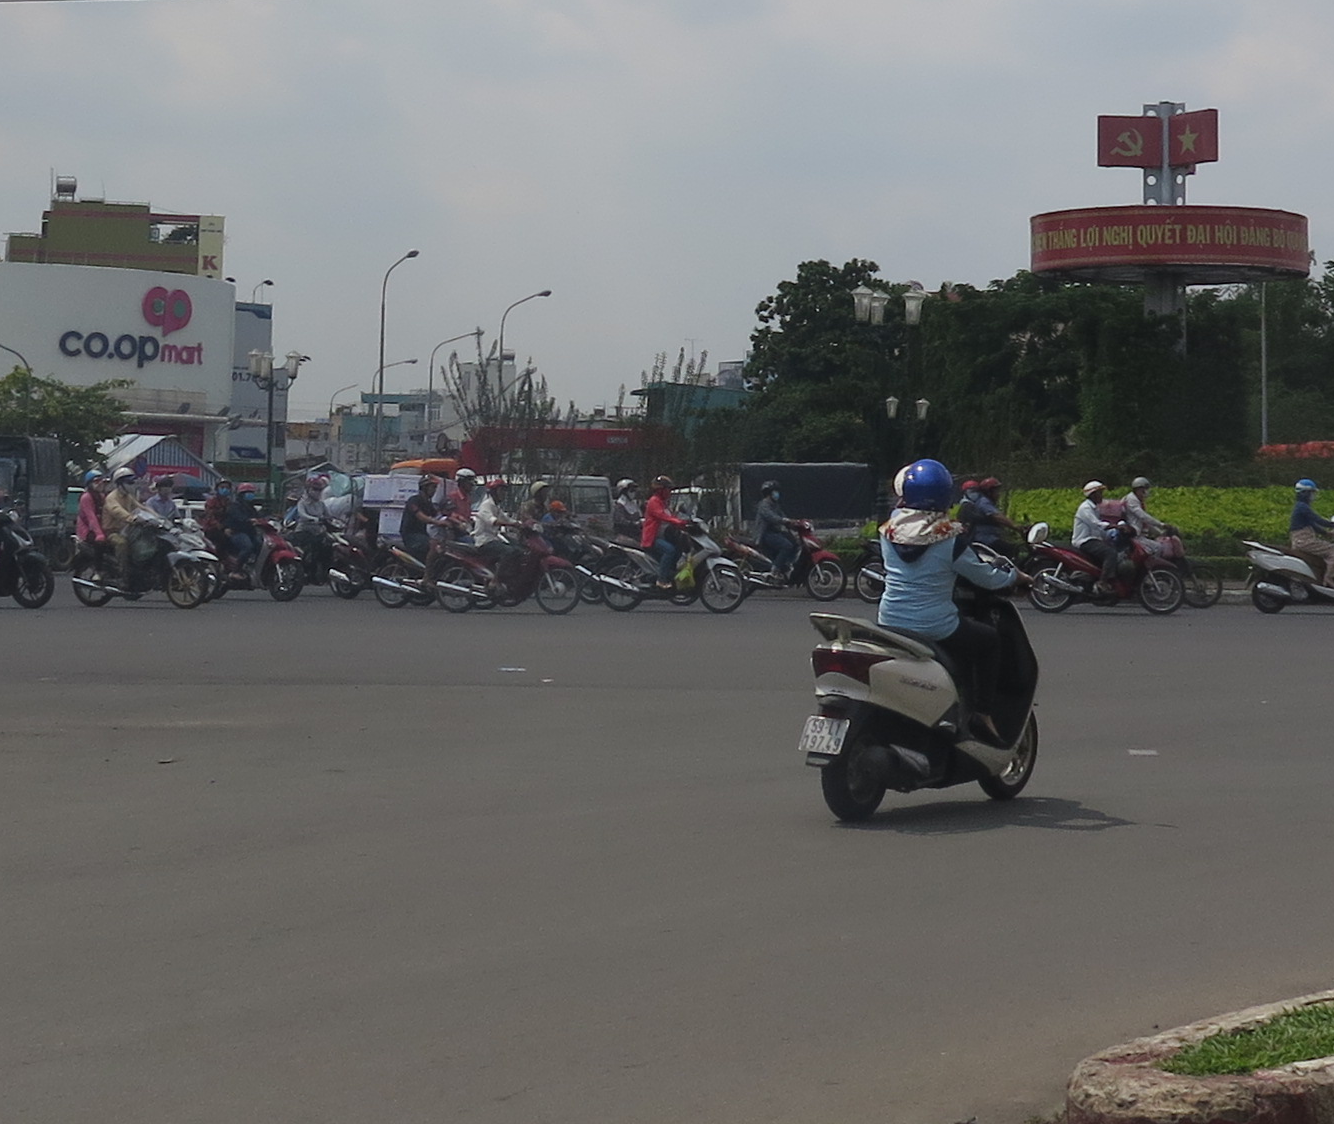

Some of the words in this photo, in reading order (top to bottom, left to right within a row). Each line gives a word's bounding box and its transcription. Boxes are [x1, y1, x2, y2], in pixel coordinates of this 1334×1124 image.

[1103, 225, 1133, 250] NGHỊ
[1138, 216, 1182, 248] QUYẾT
[1187, 225, 1210, 249] ĐẠI
[1215, 219, 1237, 249] HỘI
